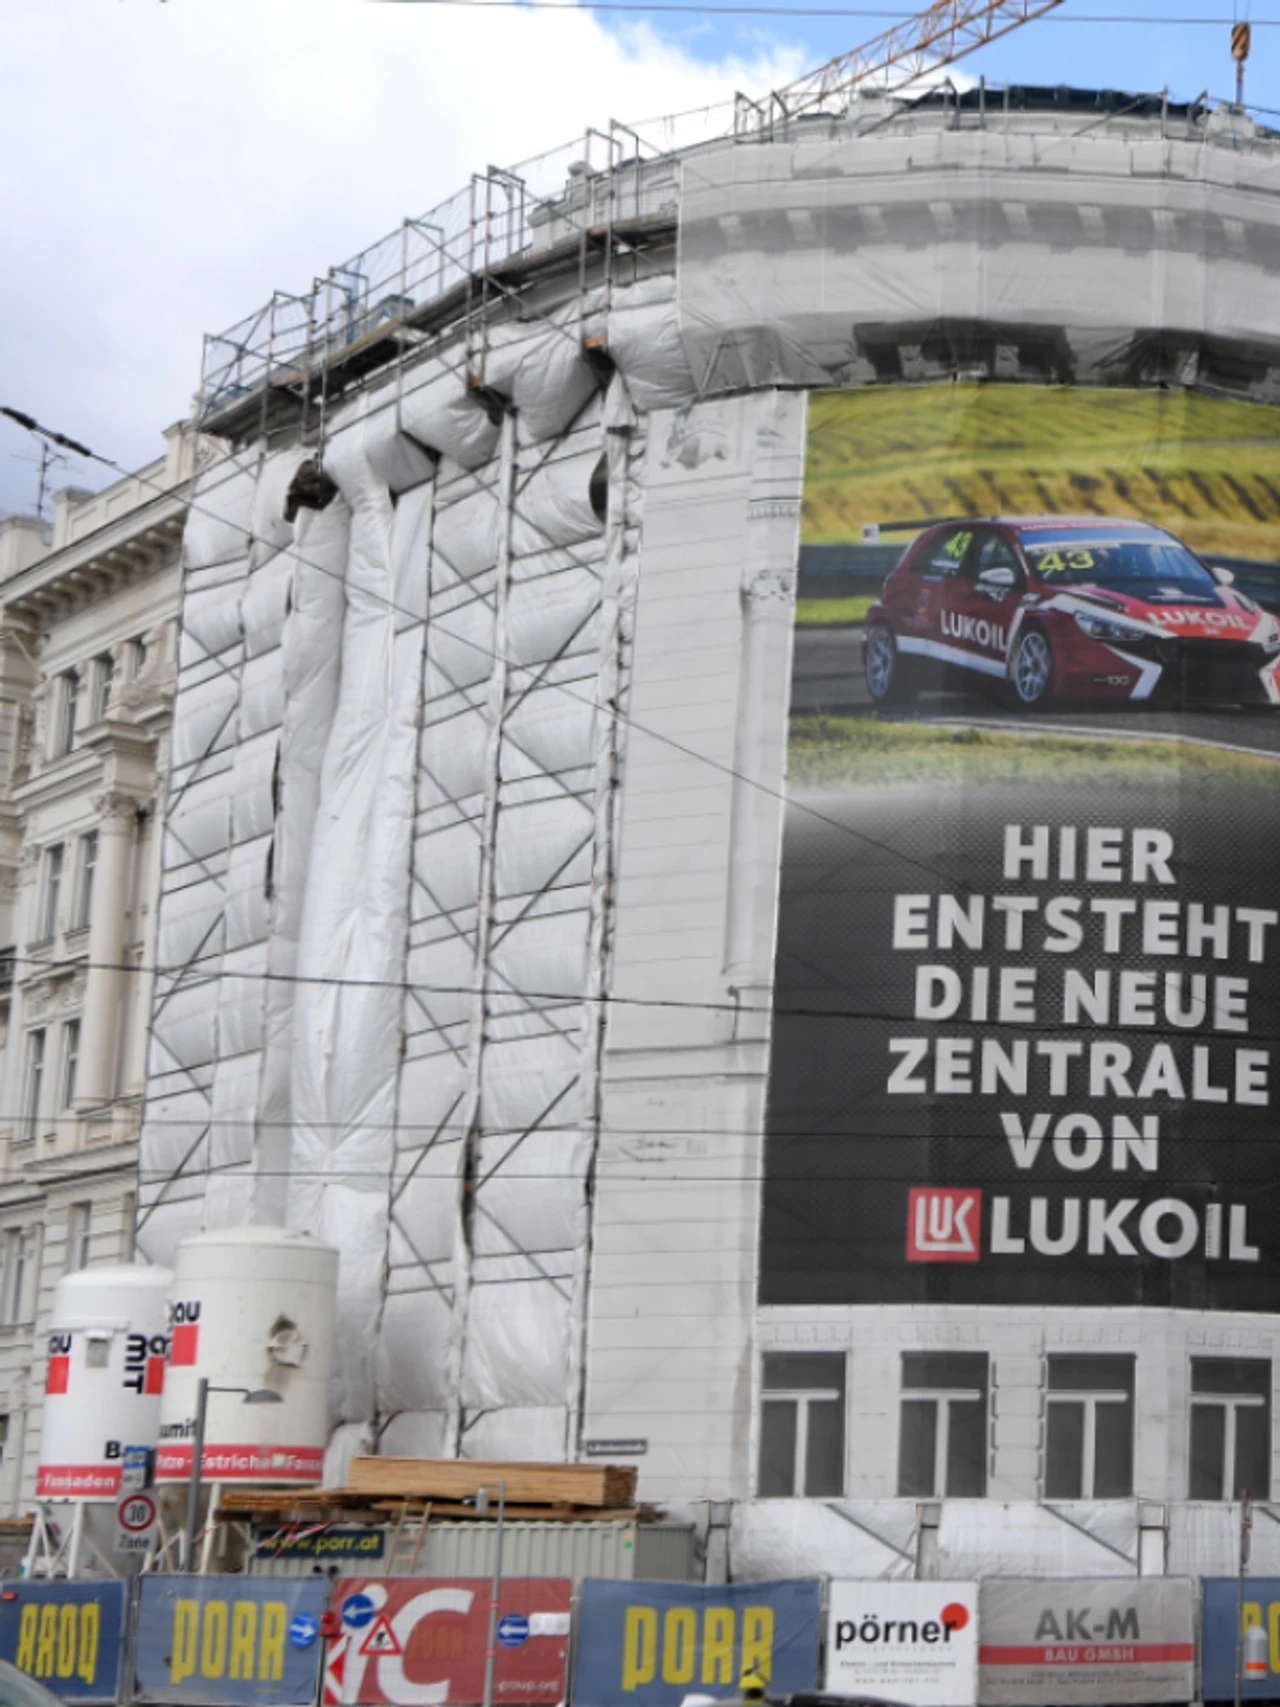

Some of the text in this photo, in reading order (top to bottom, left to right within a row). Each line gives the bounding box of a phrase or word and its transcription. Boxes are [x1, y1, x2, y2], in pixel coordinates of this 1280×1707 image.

[1037, 550, 1094, 572] 43
[941, 610, 1007, 651] LUKOIL
[1146, 609, 1250, 630] LUKOIL
[1003, 825, 1175, 883] HIER
[893, 895, 1278, 962] ENTSTEHT
[915, 966, 1249, 1031] DIE NEUE
[887, 1038, 1269, 1105] ZENTRALE
[1001, 1113, 1158, 1171] VON
[990, 1197, 1259, 1261] LUKOIL
[128, 1504, 148, 1522] 30
[171, 1598, 287, 1684] PORR
[621, 1605, 774, 1691] PORR
[835, 1614, 957, 1651] pörner
[1034, 1607, 1140, 1641] AK-M
[1044, 1647, 1134, 1662] BAU GMBH
